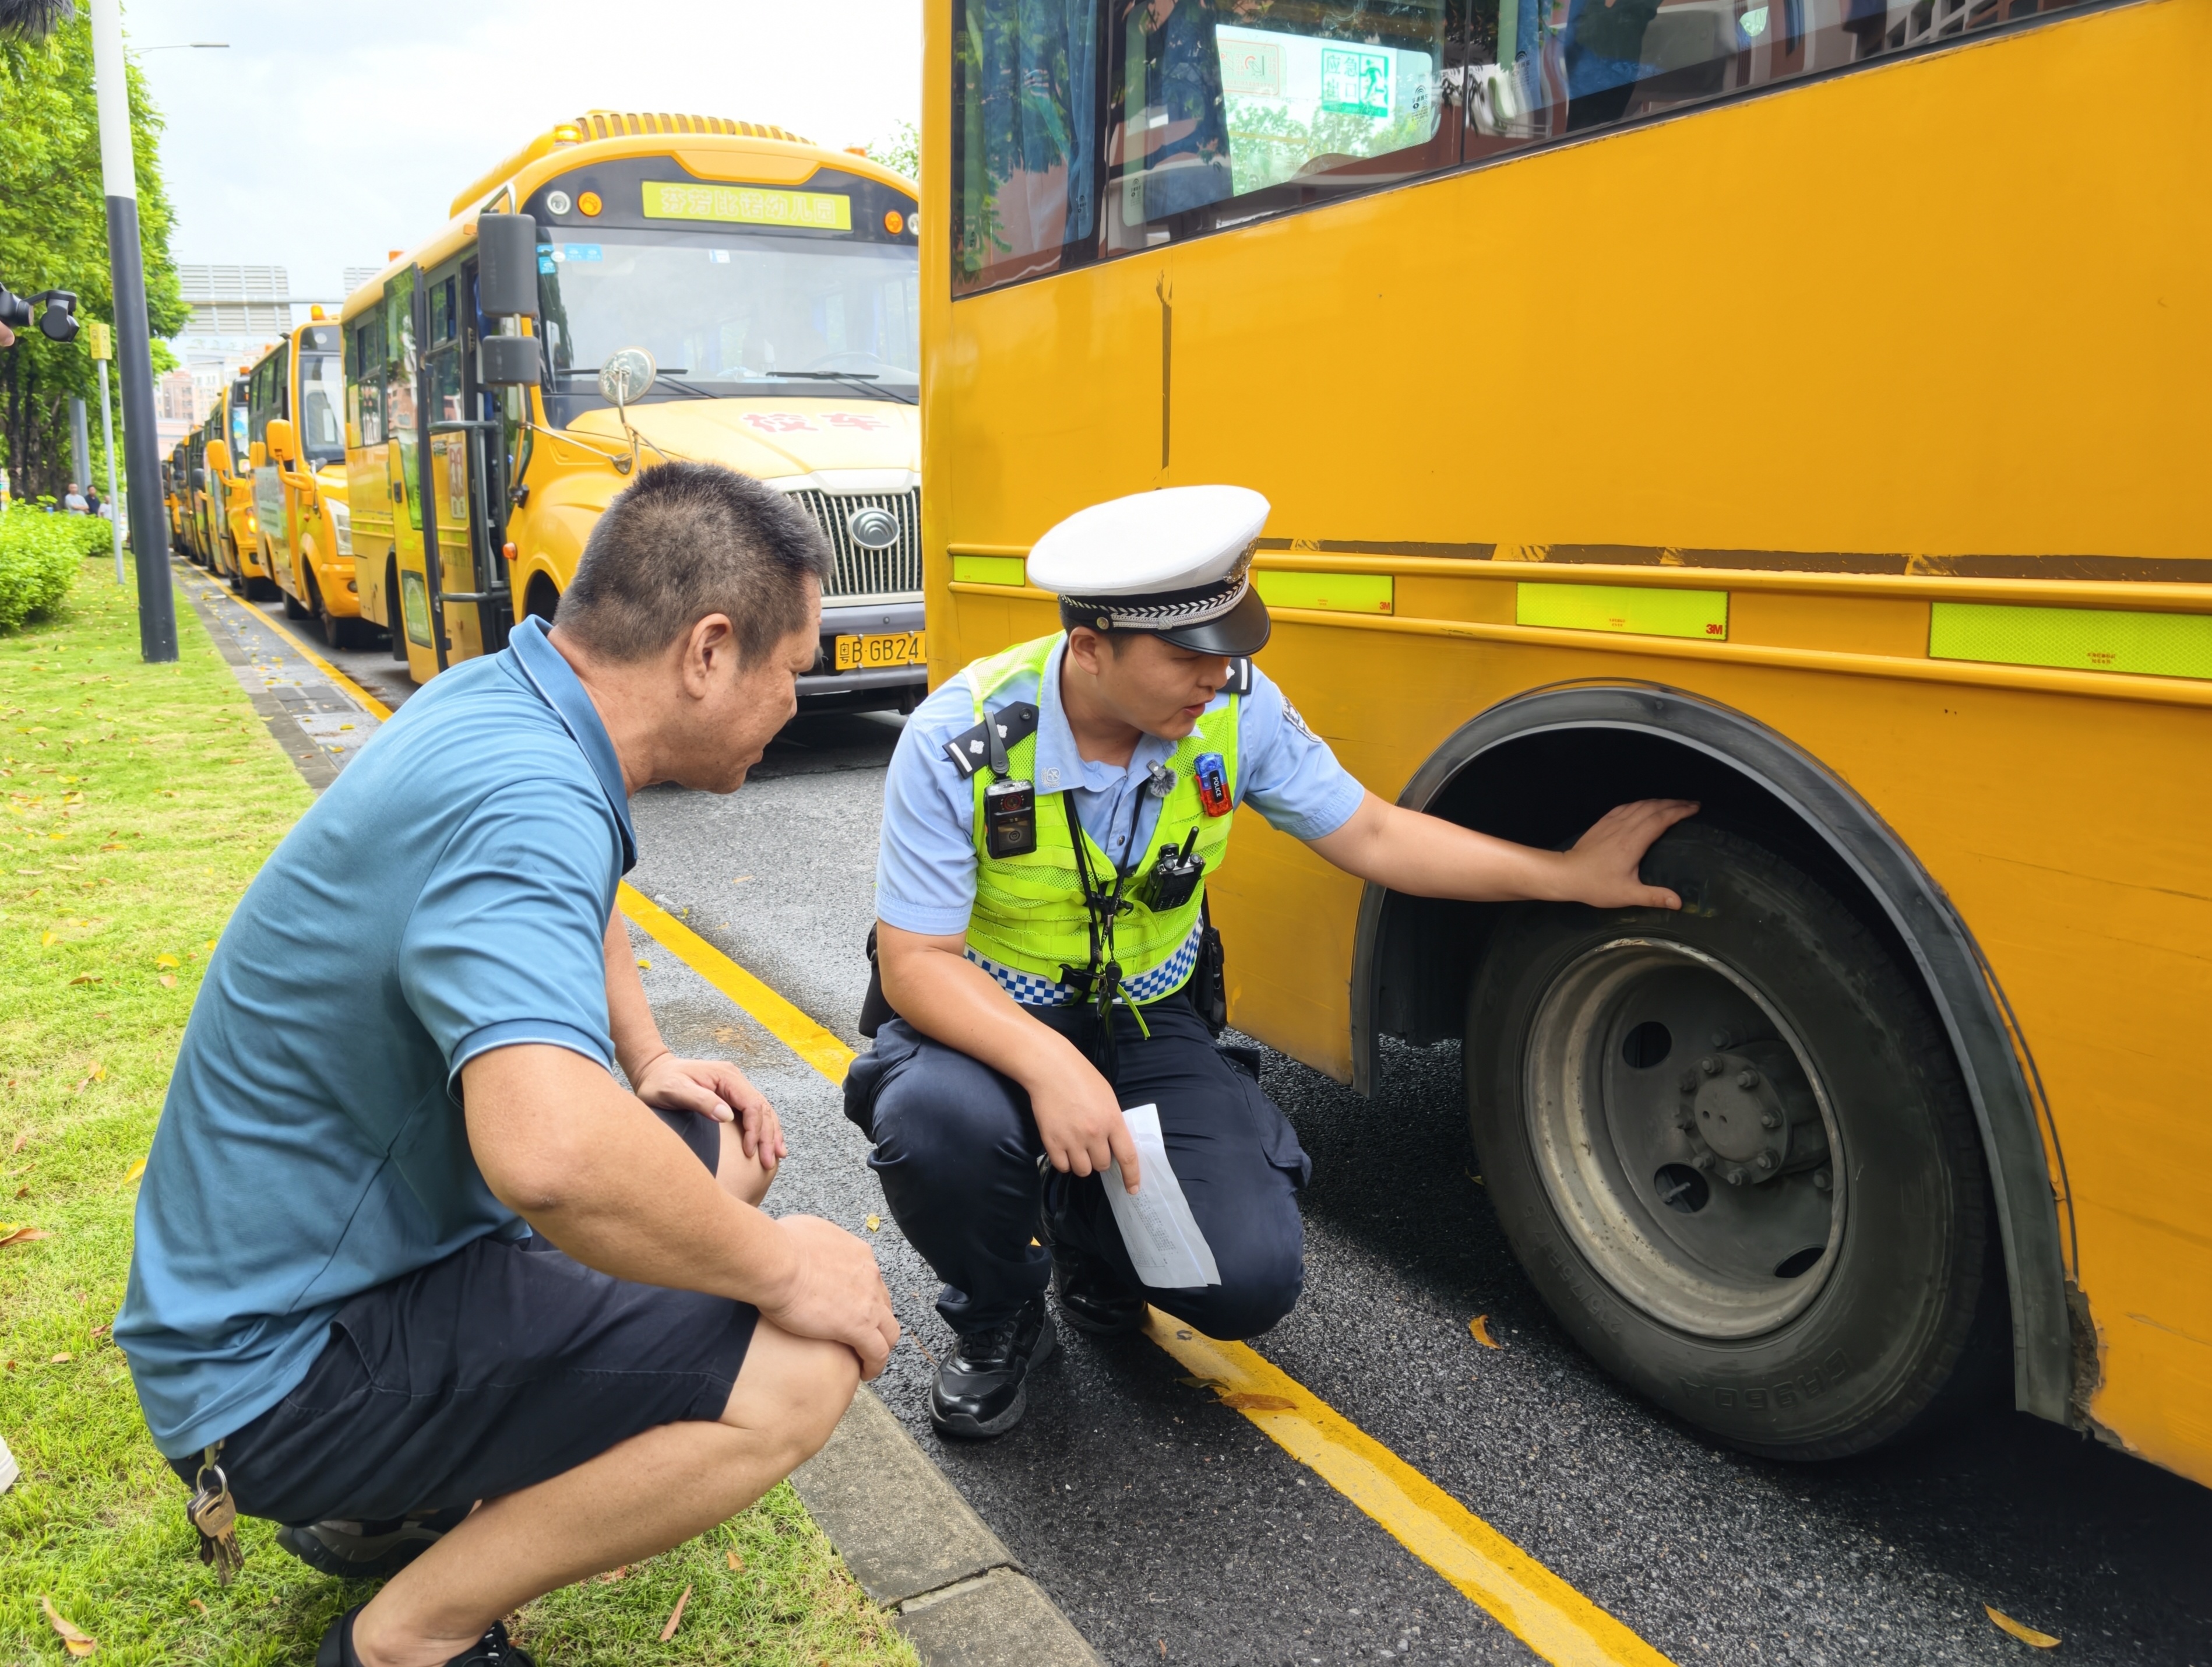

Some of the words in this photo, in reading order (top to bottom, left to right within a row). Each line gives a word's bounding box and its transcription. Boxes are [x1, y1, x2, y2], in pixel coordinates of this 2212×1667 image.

[1325, 55, 1358, 77] 应急
[660, 187, 837, 224] 芬芳比诺幼儿园
[742, 413, 892, 432] 校车
[1379, 602, 1390, 610] 3M
[1706, 624, 1723, 635] 3M
[839, 638, 927, 664] 粤B·GB24
[1213, 776, 1222, 797] POLICE
